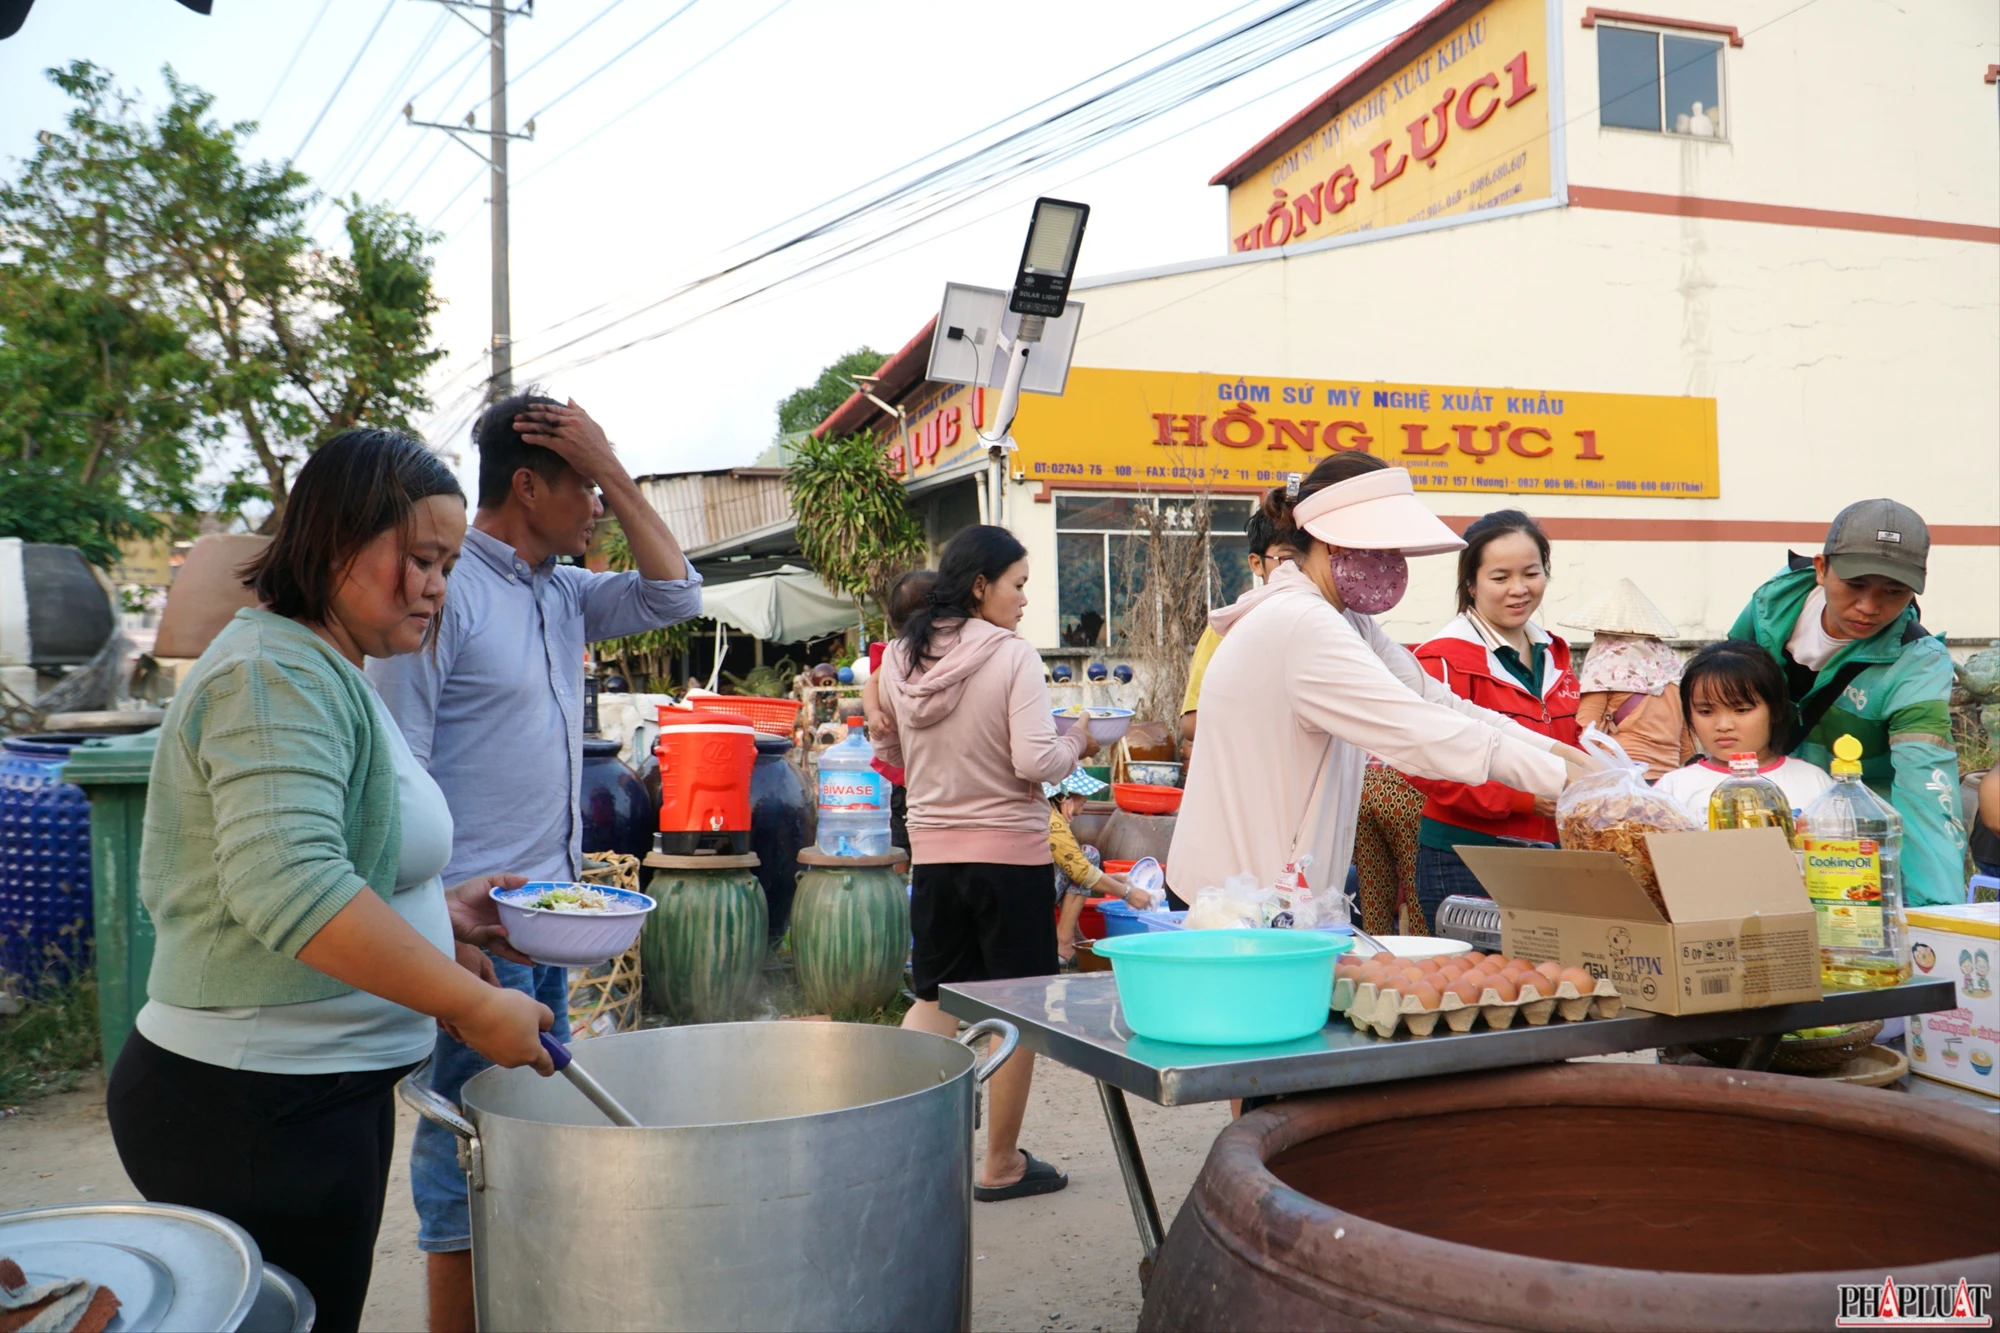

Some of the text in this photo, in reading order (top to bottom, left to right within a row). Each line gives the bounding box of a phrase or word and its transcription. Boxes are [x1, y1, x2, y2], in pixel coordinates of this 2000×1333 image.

[1234, 164, 1358, 252] HỒNG
[1019, 291, 1061, 302] SOLAR LIGHT
[1218, 377, 1565, 415] GỐM SỨ MỸ NGHỆ XUẤT KHẨU
[1152, 401, 1605, 464] HỒNG LỰC 1
[1432, 476, 1448, 486] 787
[1453, 477, 1468, 487] 157
[1842, 684, 1868, 711] rab
[823, 785, 873, 796] BIWASE
